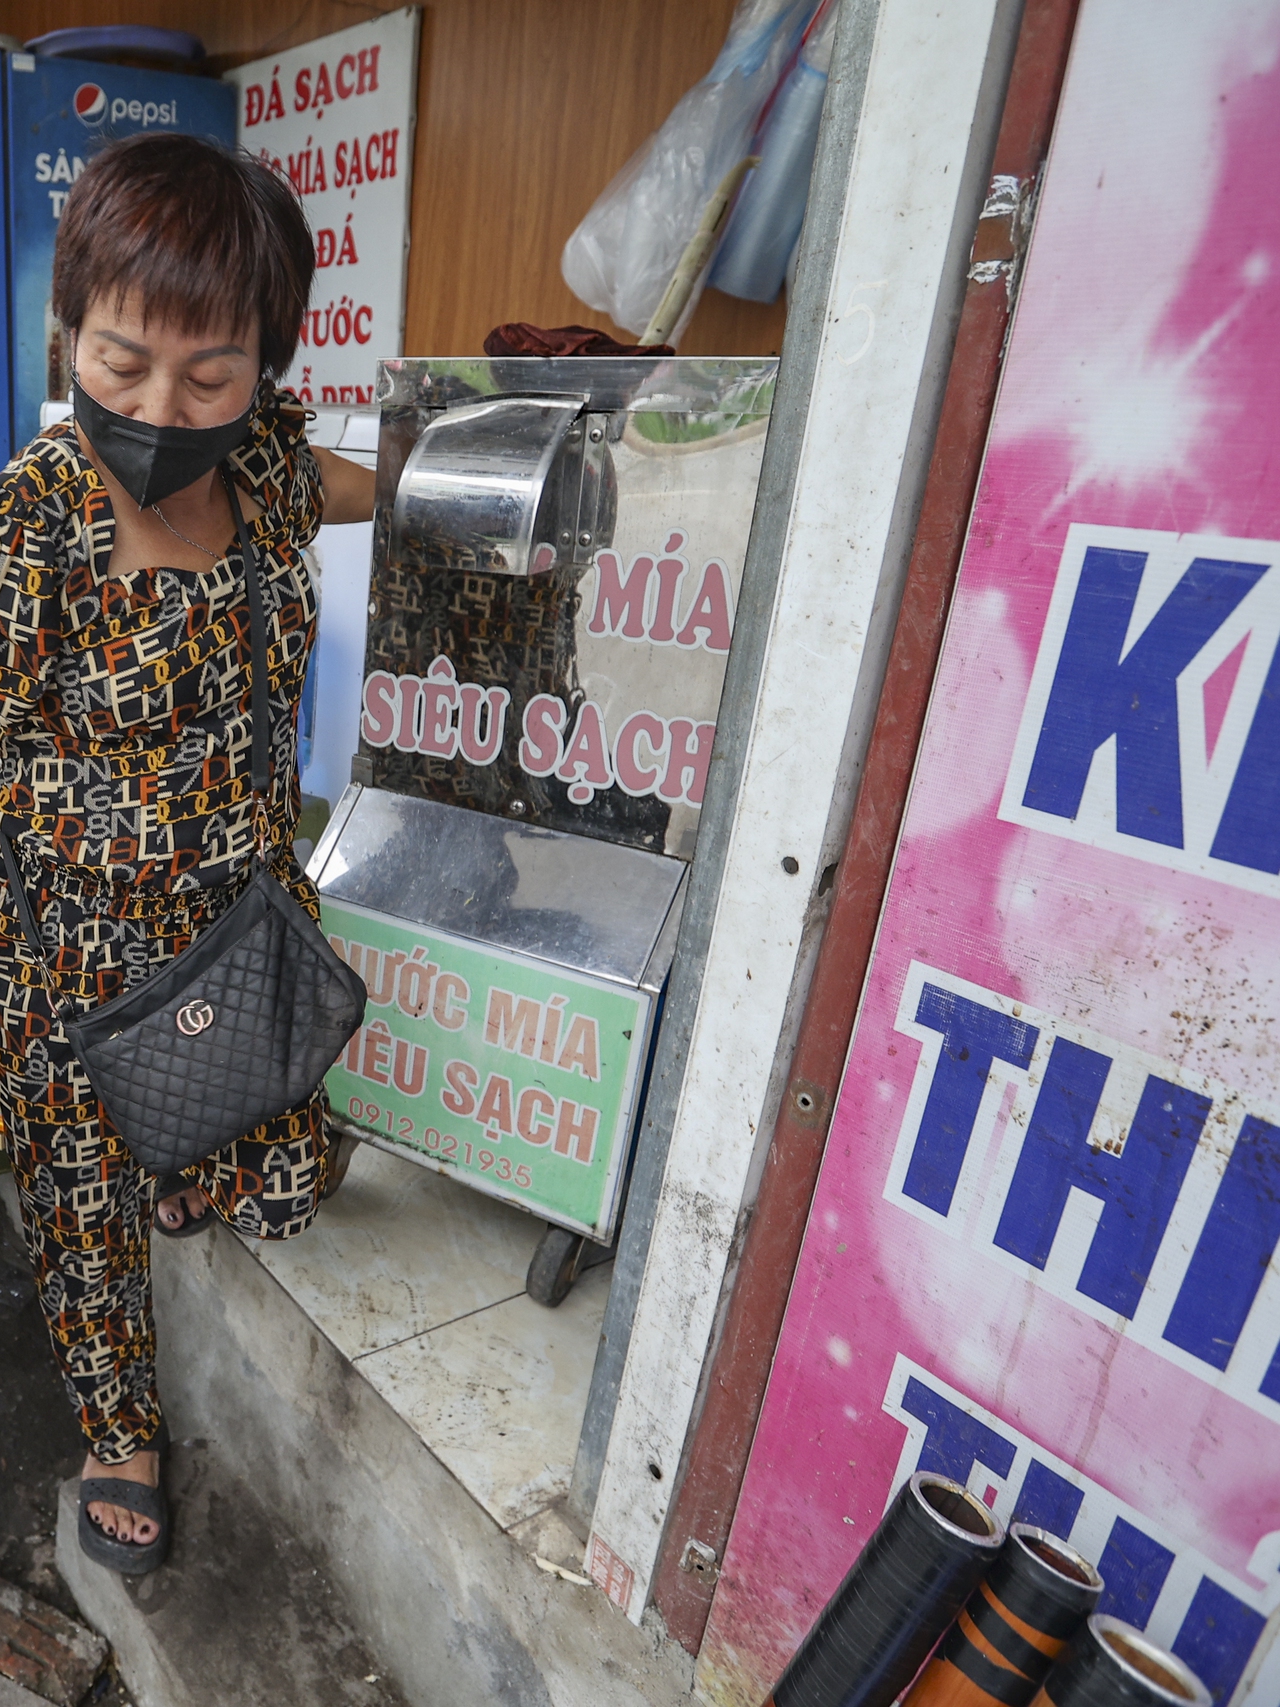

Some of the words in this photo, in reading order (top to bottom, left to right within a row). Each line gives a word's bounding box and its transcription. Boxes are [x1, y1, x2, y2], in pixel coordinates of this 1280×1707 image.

[111, 97, 177, 127] pepsi
[245, 64, 285, 127] ĐÁ
[294, 44, 381, 120] SẠCH
[288, 135, 328, 197] MÍA
[334, 127, 399, 199] SẠCH
[587, 530, 733, 653] MÍA
[361, 656, 510, 766] SIÊU
[520, 694, 717, 808] SẠCH
[483, 986, 602, 1082] MÍA
[332, 1019, 429, 1097] IÊU
[440, 1058, 601, 1166] SẠCH
[348, 1097, 533, 1189] 0912.021935
